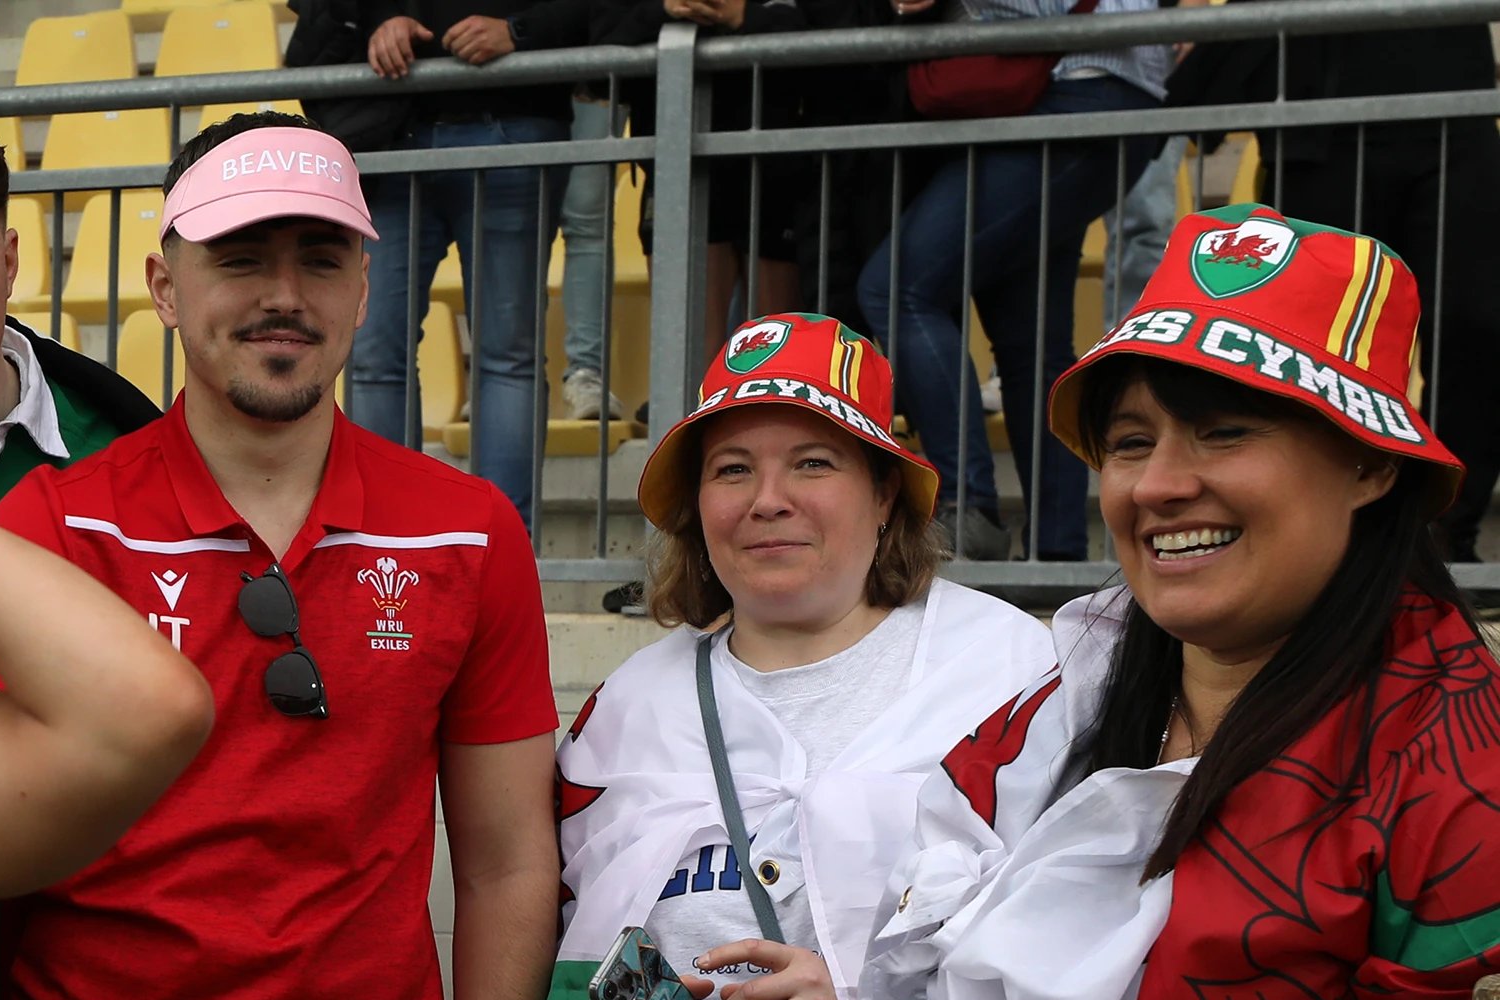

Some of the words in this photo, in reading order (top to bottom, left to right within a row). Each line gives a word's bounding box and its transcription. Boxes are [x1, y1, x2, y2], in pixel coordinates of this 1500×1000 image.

[222, 149, 343, 183] BEAVERS
[1201, 319, 1424, 444] CYMRU
[735, 378, 901, 449] CYMRU
[375, 619, 404, 633] WRU
[370, 638, 410, 651] EXILES
